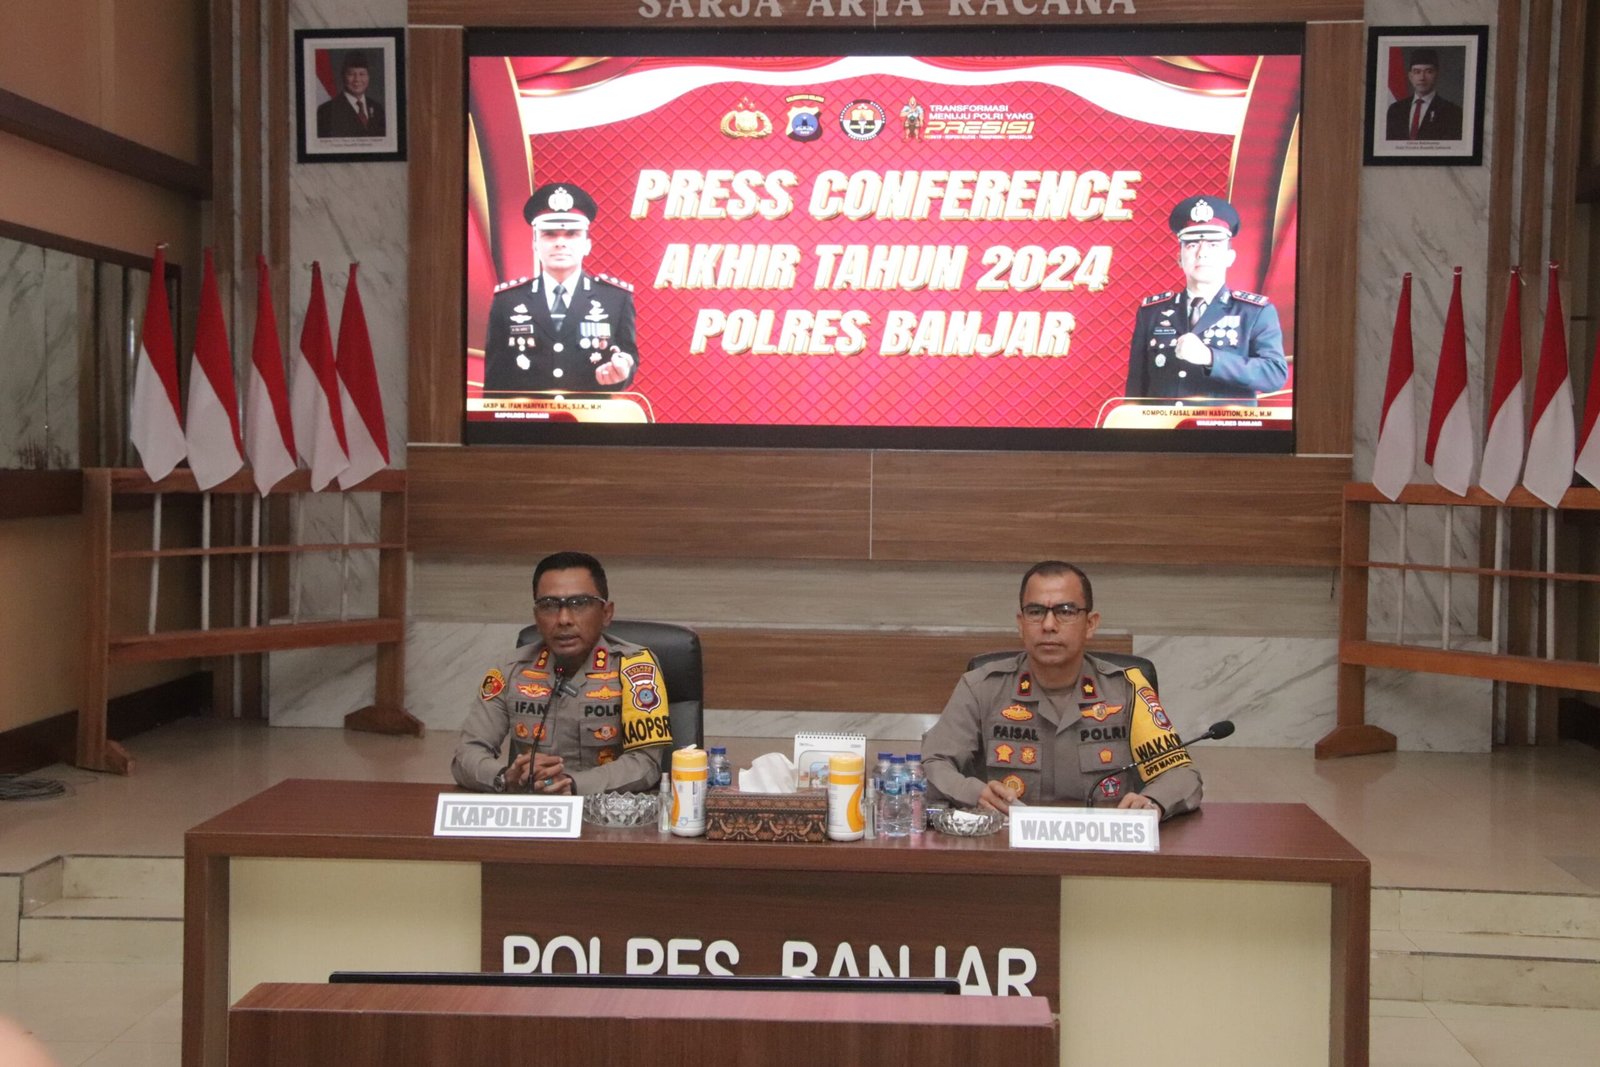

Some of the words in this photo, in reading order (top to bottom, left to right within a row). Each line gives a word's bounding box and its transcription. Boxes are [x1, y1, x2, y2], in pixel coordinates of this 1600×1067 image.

[928, 112, 971, 120] MENUJU
[973, 112, 1003, 120] POLRI
[1005, 112, 1034, 120] YANG
[929, 104, 1009, 112] TRANSFORMASI
[924, 120, 1036, 135] PRESISI
[629, 168, 798, 220] PRESS
[809, 169, 1143, 222] CONFERENCE
[654, 243, 802, 290] AKHIR
[814, 244, 969, 291] TAHUN
[975, 245, 1113, 292] 2024
[690, 308, 872, 356] POLRES
[878, 310, 1077, 358] BANJAR
[515, 701, 548, 715] IFAN
[584, 704, 621, 717] POLR
[993, 725, 1039, 741] FAISAL
[1080, 725, 1127, 742] POLRI
[450, 806, 563, 828] KAPOLRES
[1020, 819, 1146, 844] WAKAPOLRES
